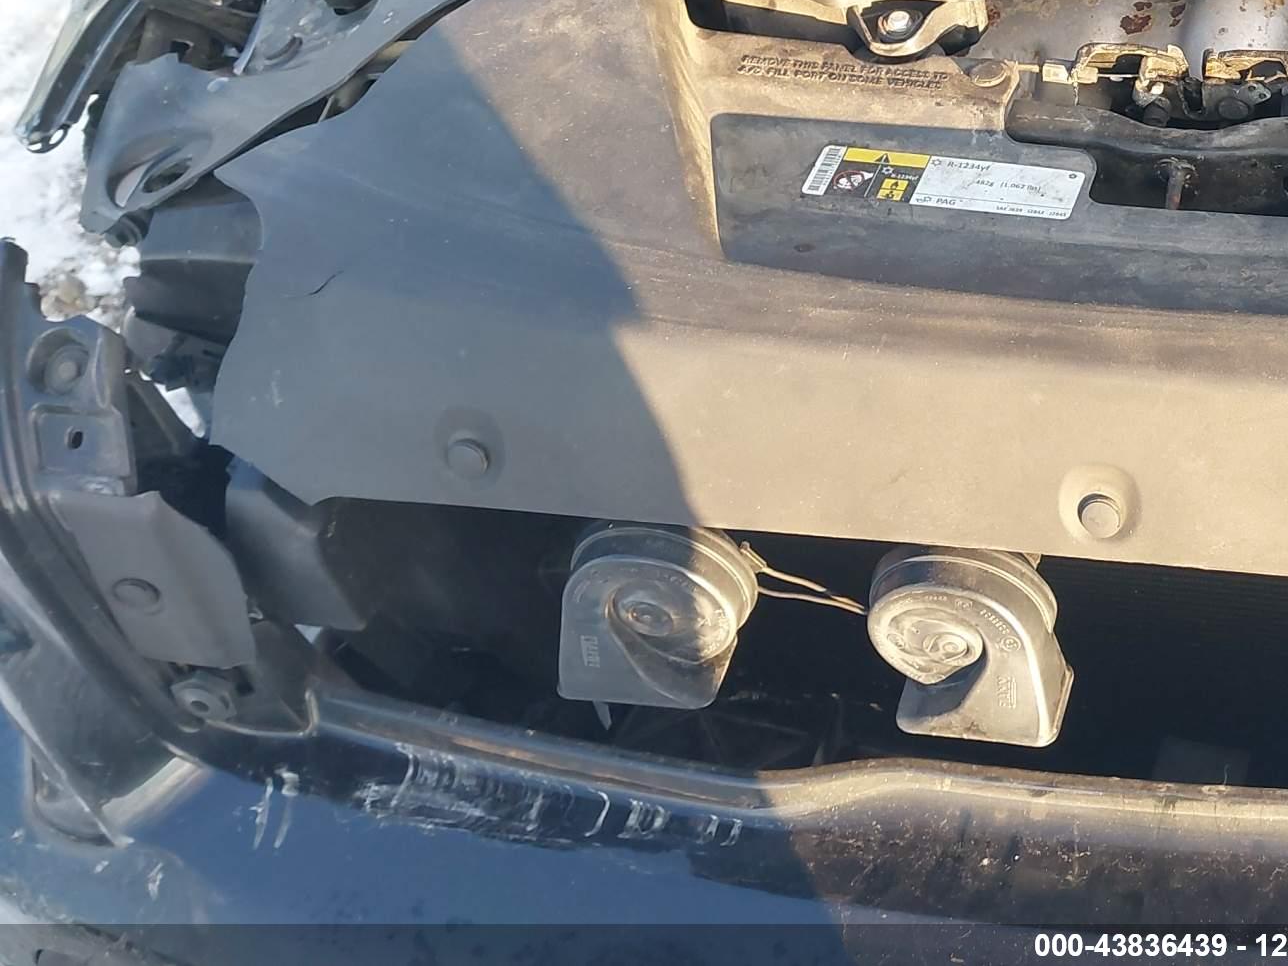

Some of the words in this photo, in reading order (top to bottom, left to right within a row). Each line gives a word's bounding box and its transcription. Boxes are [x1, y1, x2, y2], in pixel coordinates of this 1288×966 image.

[741, 54, 791, 67] REMOVE
[860, 65, 885, 76] FOR
[933, 71, 951, 81] TO
[766, 67, 791, 78] FILL
[793, 69, 826, 82] PORT
[946, 161, 991, 172] R-1234yf
[936, 198, 956, 206] PAG
